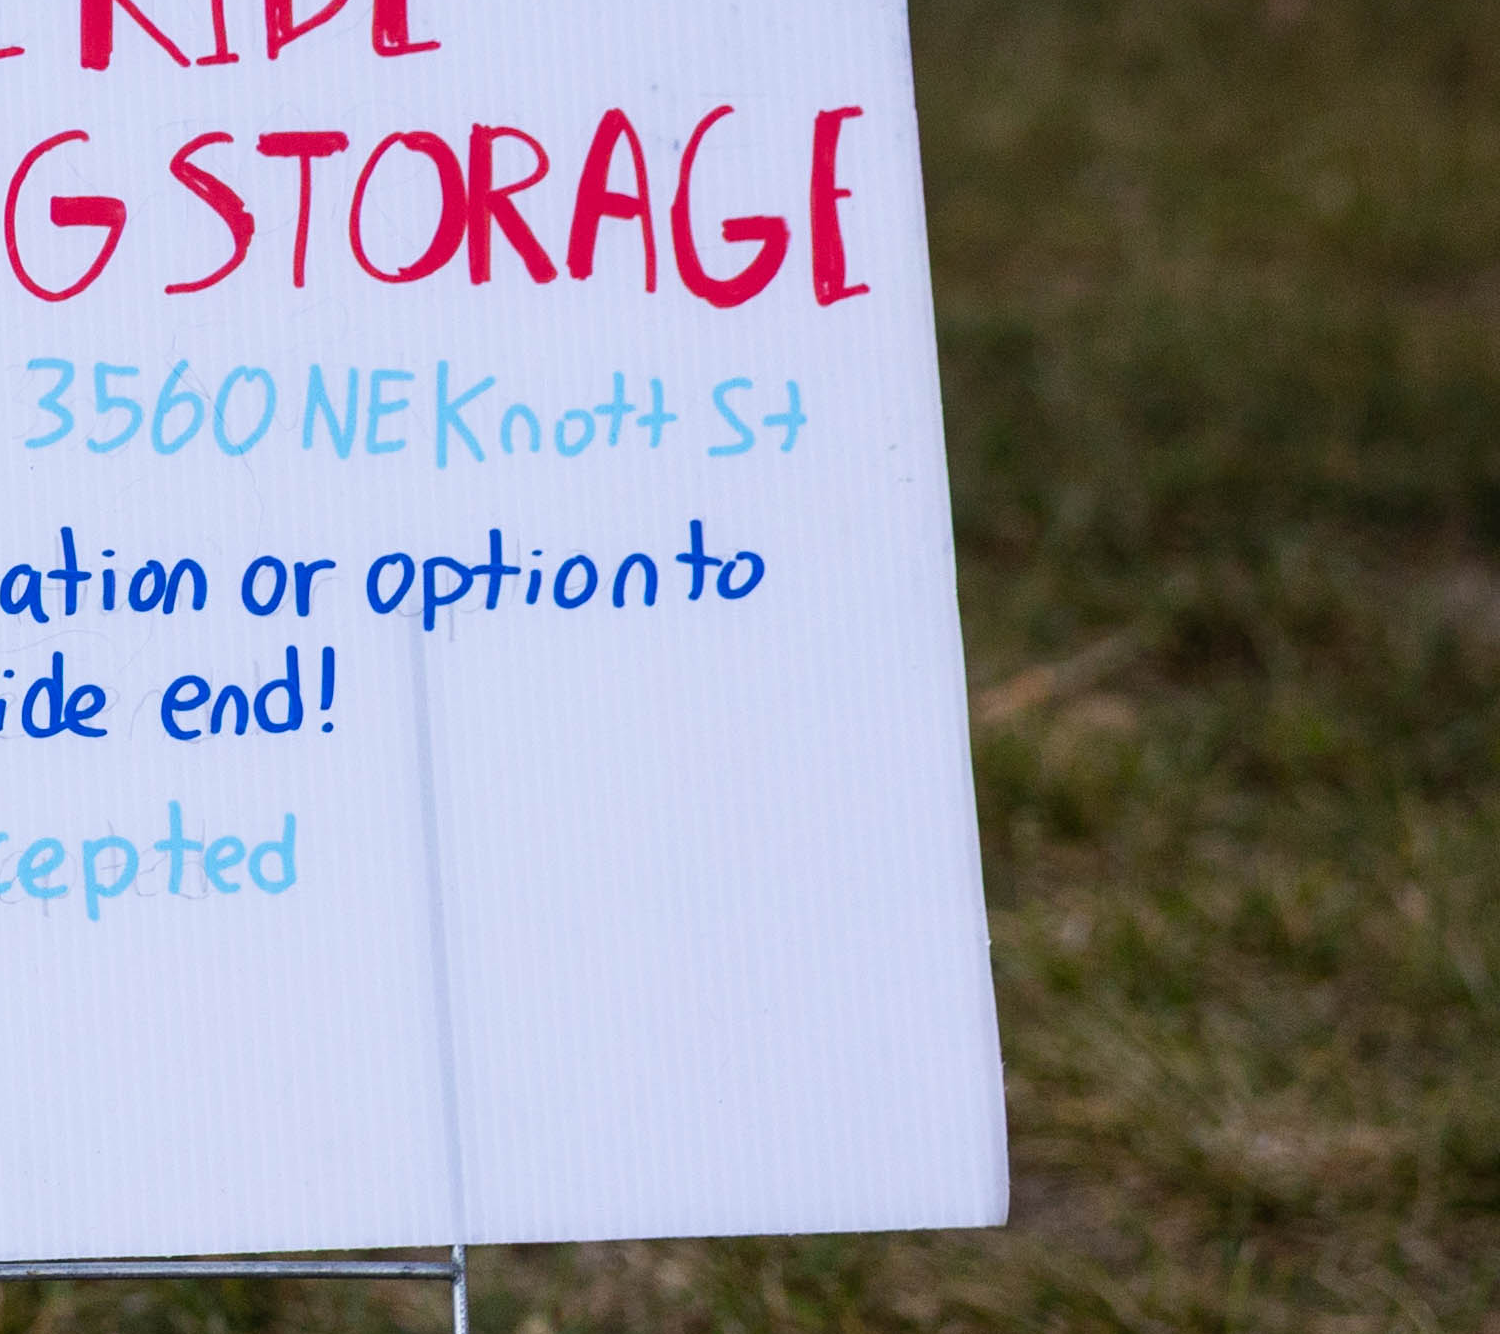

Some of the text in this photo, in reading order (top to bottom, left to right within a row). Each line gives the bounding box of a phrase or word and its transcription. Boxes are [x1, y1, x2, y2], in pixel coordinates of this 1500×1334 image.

[163, 103, 872, 311] STORAGE
[23, 356, 278, 461] 3560
[706, 375, 810, 459] St
[238, 553, 339, 620] or
[158, 642, 338, 745] end!
